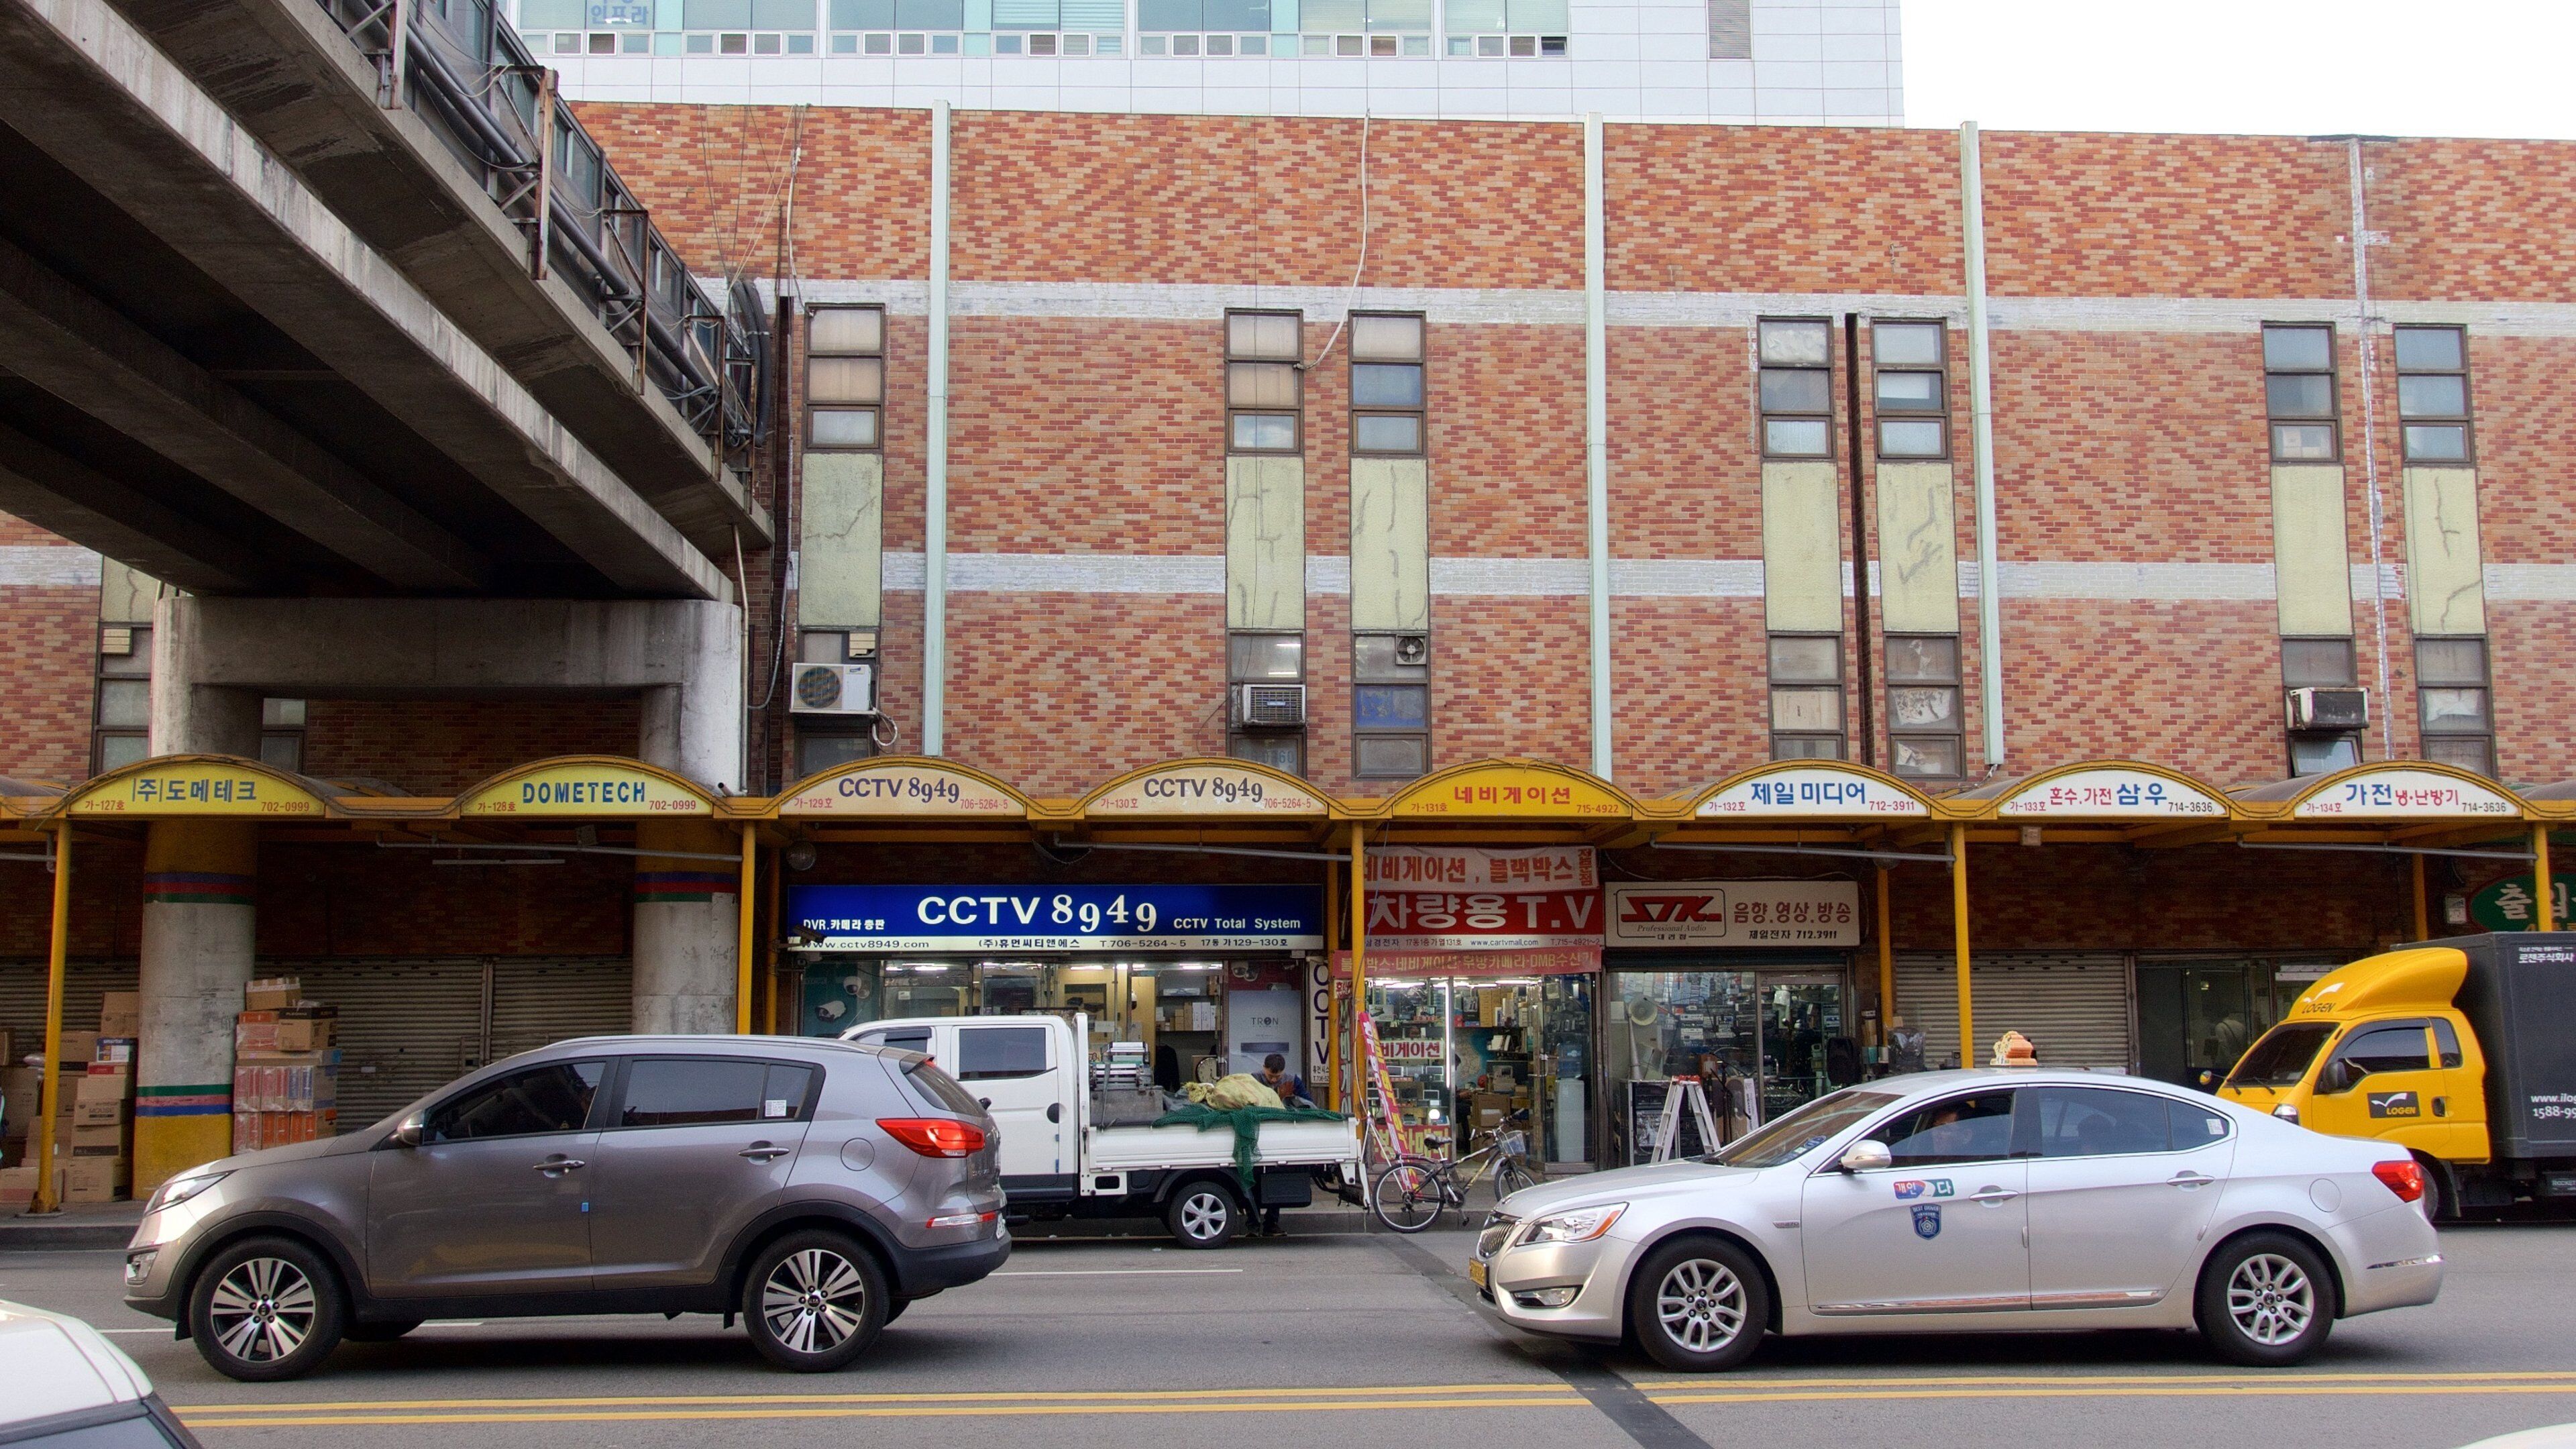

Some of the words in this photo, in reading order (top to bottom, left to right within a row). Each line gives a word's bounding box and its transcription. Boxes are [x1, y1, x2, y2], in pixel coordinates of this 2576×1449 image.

[523, 782, 645, 804] DOMETECH
[839, 778, 903, 798] CCTV
[908, 777, 959, 803] 8949
[1144, 778, 1207, 798] CCTV
[1212, 777, 1263, 802] 8949
[1752, 782, 1794, 805] 제일
[1801, 782, 1866, 805] 미디어
[2116, 783, 2167, 806] 삼우
[2346, 784, 2392, 805] 가전
[1454, 787, 1570, 804] 네비게이션
[85, 800, 125, 811] 가-127호
[261, 802, 309, 812] 702-0999
[478, 802, 517, 812] 가-128호
[649, 800, 696, 810] 702-0999
[794, 798, 833, 809] 가-129호
[1101, 798, 1138, 809] 가-130호
[1411, 803, 1448, 812] 가-131호
[1576, 804, 1619, 814] 715-4922
[1709, 801, 1746, 811] 가-132호
[1869, 801, 1915, 811] 712-3911
[2010, 801, 2046, 811] 가-133호
[2168, 802, 2213, 812] 714-3636
[2306, 802, 2342, 812] 가-134호
[2462, 802, 2506, 812] 714-3636
[1490, 857, 1572, 883] 블랙박스
[2495, 883, 2576, 919] 출입
[917, 896, 1040, 924] CCTV
[1051, 894, 1157, 932] 8949
[1368, 894, 1508, 930] 차량용
[1516, 895, 1595, 929] T.V
[864, 919, 885, 930] 총판
[1173, 918, 1208, 929] CCTV
[1215, 918, 1246, 929] Total
[1254, 918, 1301, 931] System
[1749, 930, 1791, 940] 제일전자
[1796, 930, 1837, 940] 712.3911
[1470, 938, 1538, 947] www.cartvmall.com
[2302, 1003, 2336, 1014] LOGEN
[1250, 1017, 1279, 1026] TRON
[2387, 1107, 2416, 1115] LOGEN
[1896, 1183, 1917, 1195] 개인
[1937, 1181, 1952, 1195] 다
